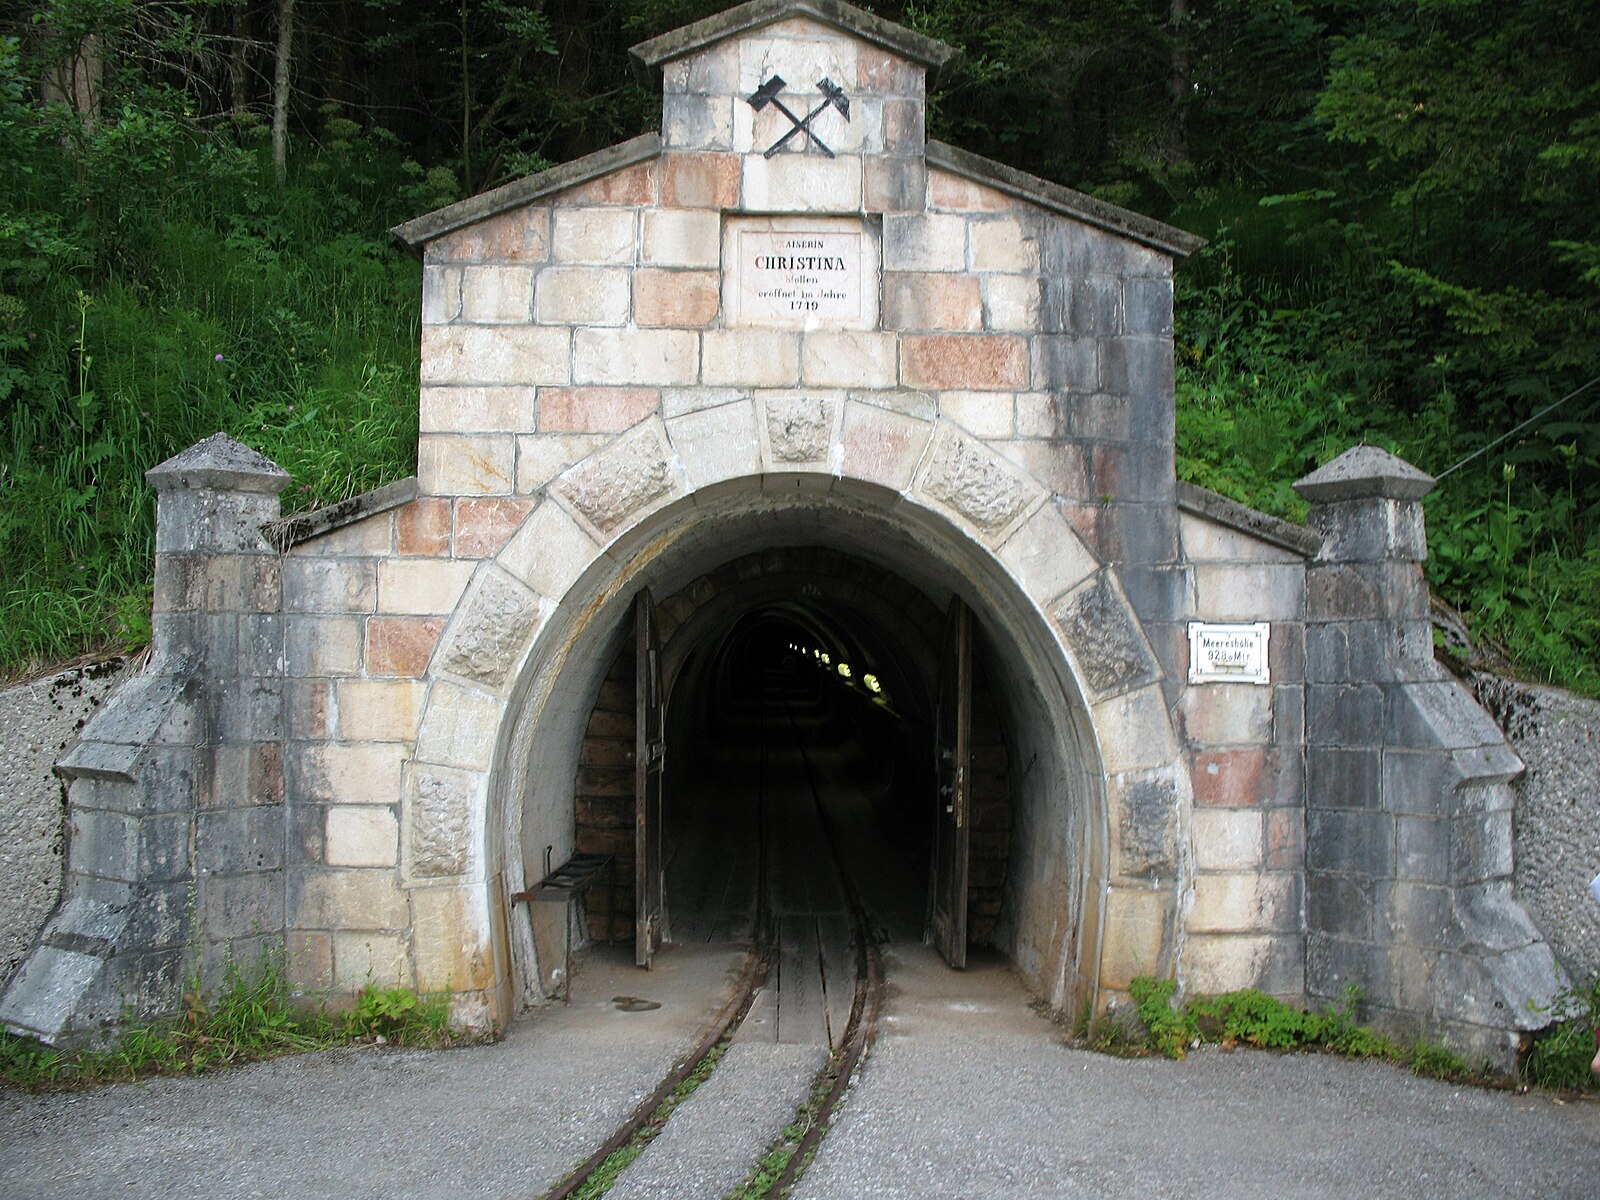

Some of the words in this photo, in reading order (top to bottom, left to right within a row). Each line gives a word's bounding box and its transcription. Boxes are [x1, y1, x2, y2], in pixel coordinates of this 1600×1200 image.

[754, 255, 847, 271] CHRISTINA
[785, 275, 818, 284] Stollen
[801, 290, 813, 299] im
[817, 288, 847, 299] Jahre
[790, 301, 819, 311] 1719
